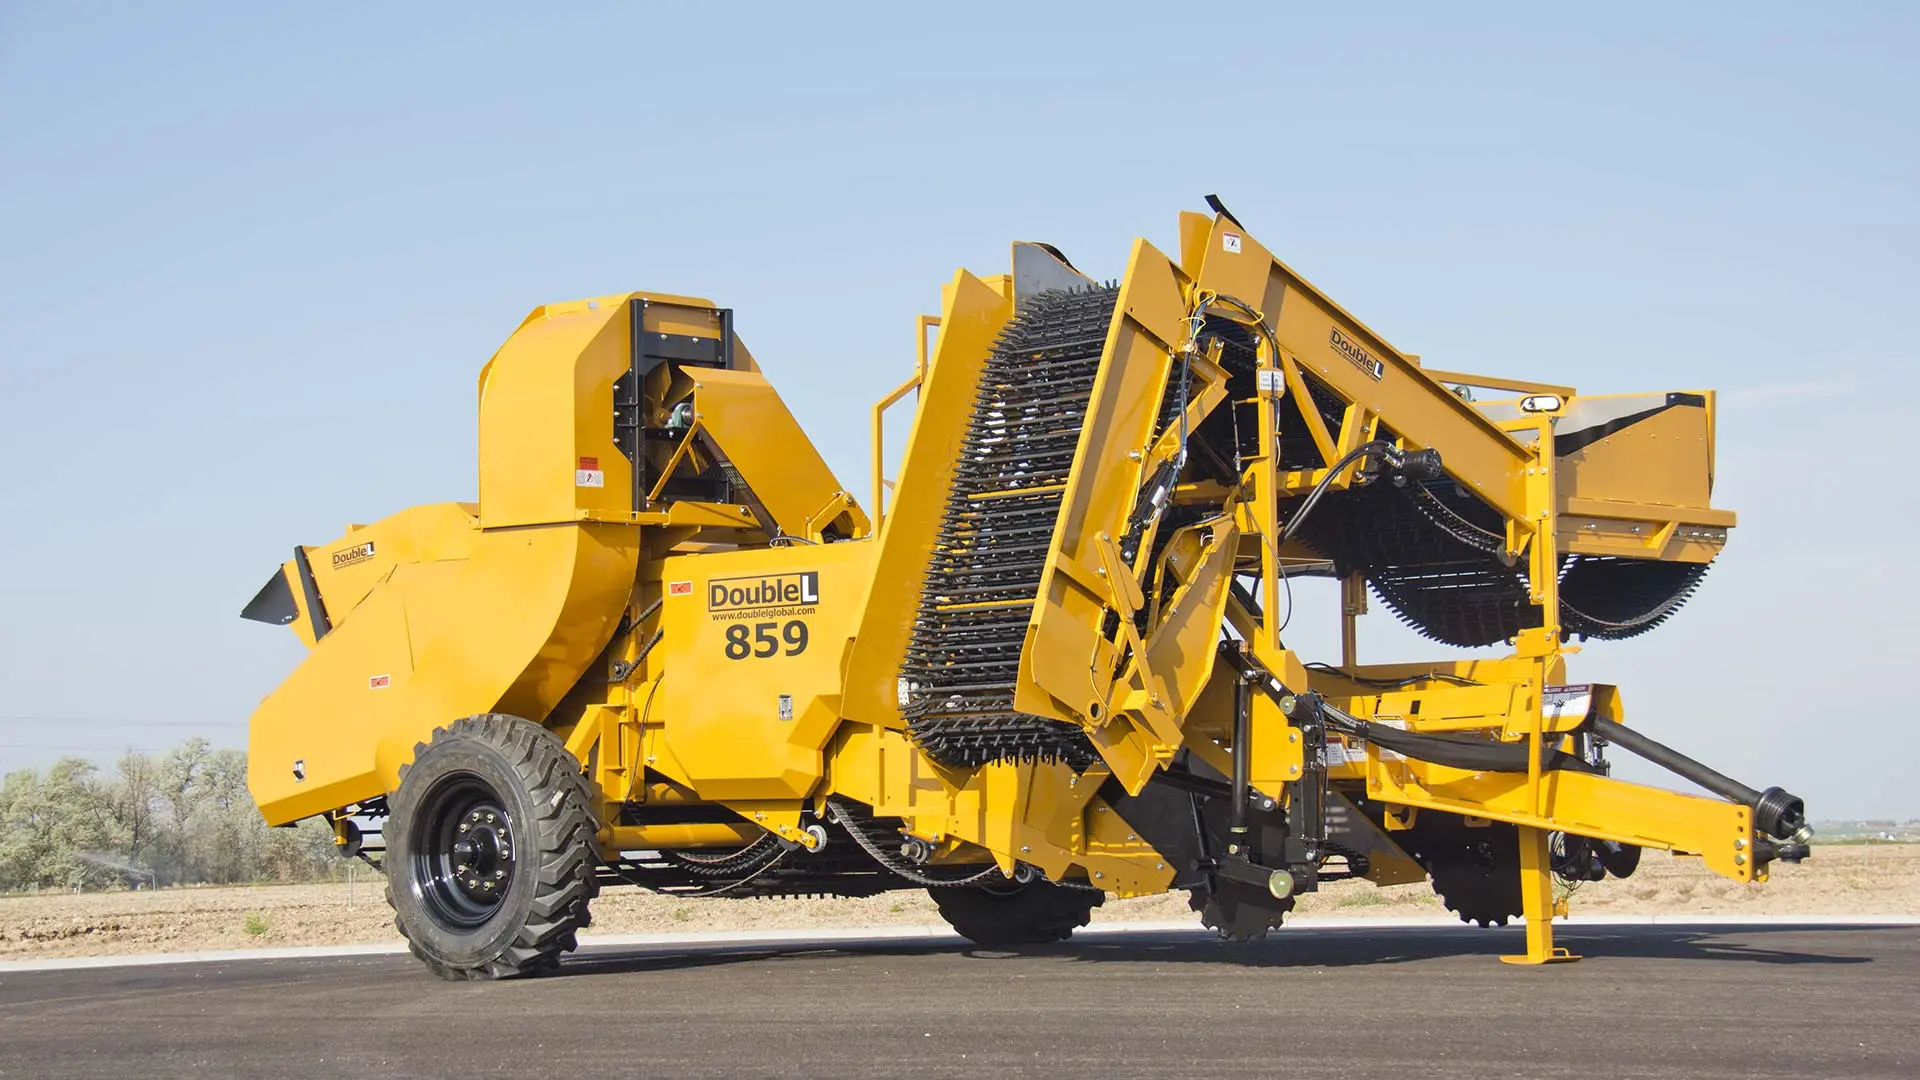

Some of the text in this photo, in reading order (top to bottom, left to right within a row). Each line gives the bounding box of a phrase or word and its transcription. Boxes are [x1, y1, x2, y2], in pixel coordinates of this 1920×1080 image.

[711, 574, 818, 607] DoubleL
[712, 607, 816, 621] www.doublelglobal.com
[725, 620, 809, 660] 859
